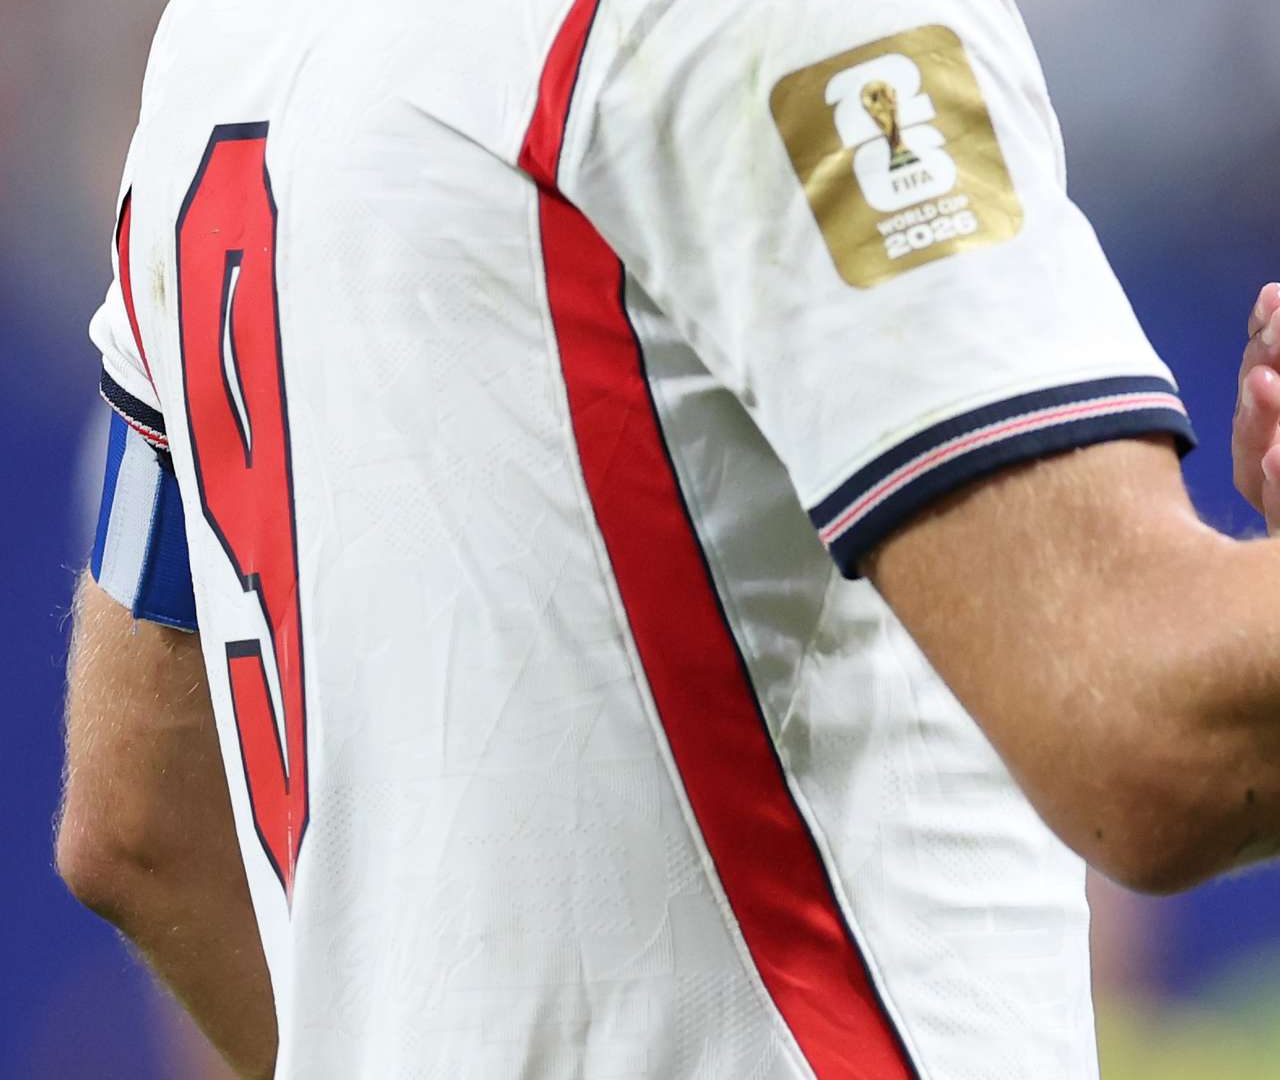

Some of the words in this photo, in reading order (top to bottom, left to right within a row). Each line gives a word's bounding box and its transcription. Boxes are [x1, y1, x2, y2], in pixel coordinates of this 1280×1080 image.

[891, 169, 935, 194] FIFA
[884, 209, 978, 260] 2026
[175, 120, 310, 916] 9
